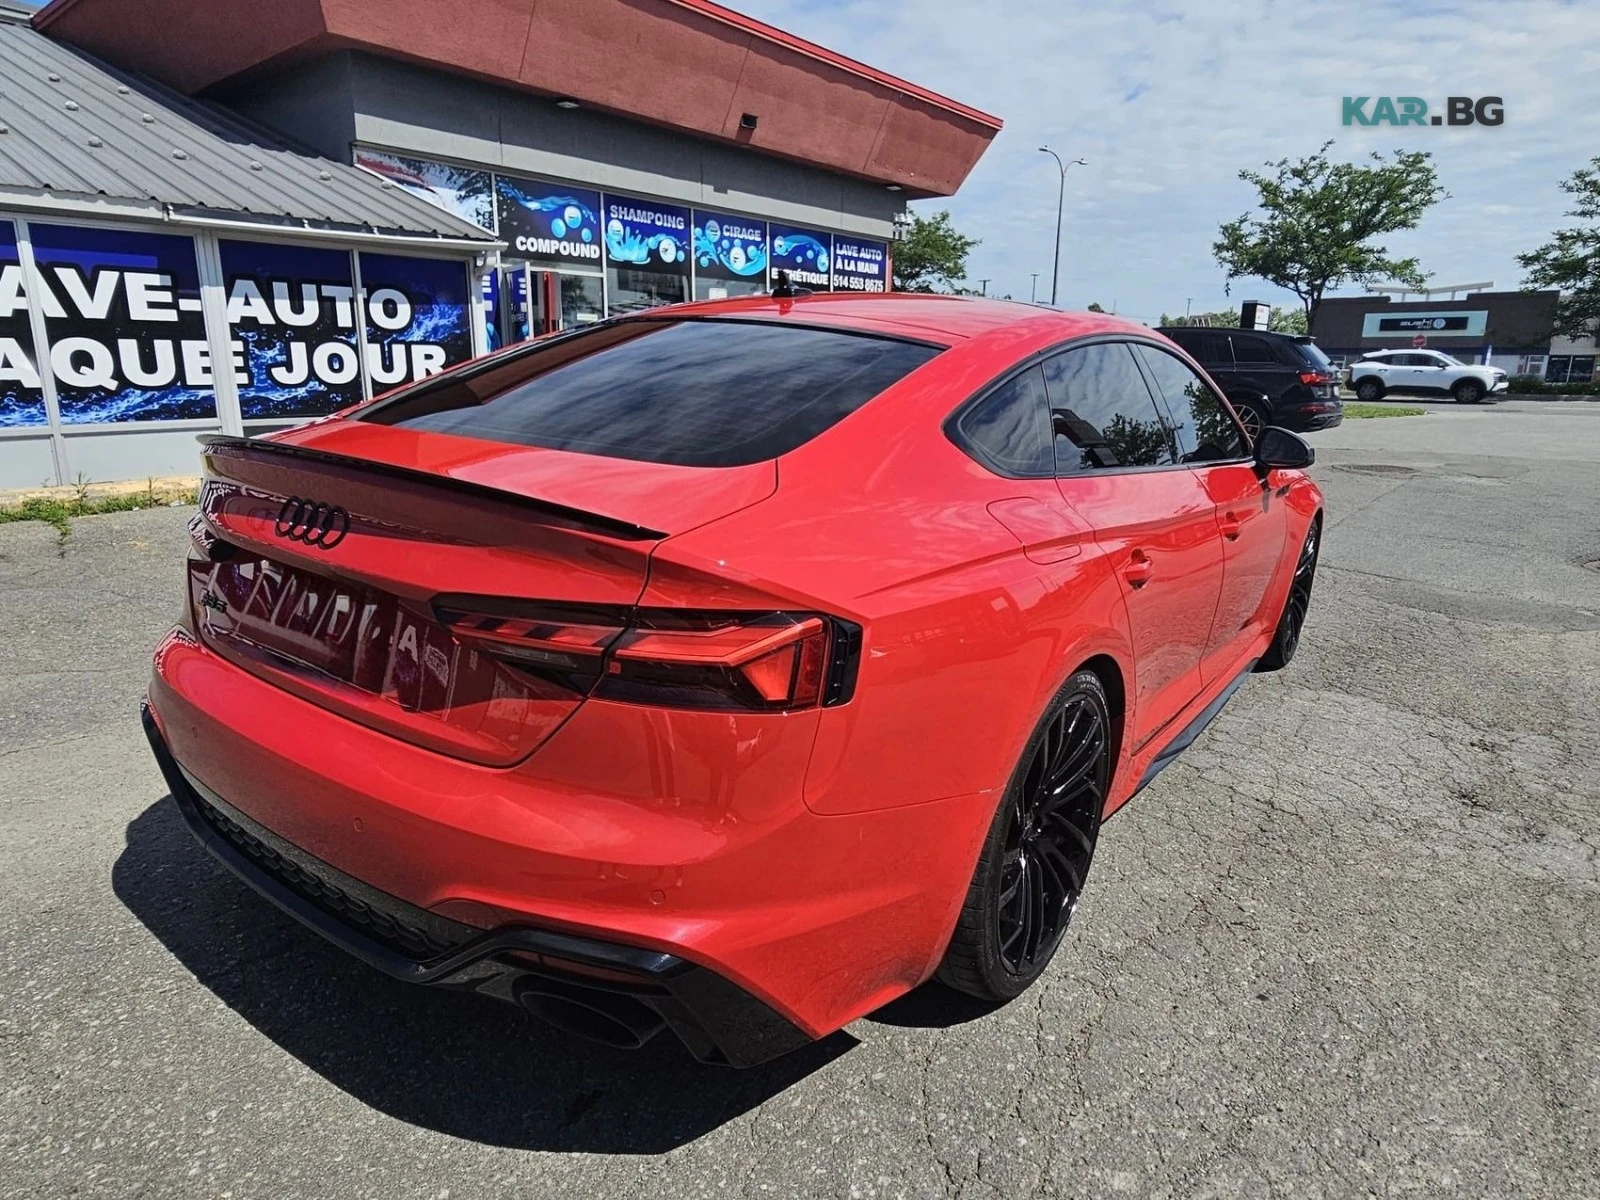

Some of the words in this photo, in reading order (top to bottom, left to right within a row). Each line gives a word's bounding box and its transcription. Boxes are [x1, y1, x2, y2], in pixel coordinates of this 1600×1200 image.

[610, 205, 685, 230] SHAMPOING
[722, 224, 762, 241] CIRAGE
[516, 235, 600, 259] COMPOUND
[836, 243, 858, 257] LAVE
[860, 247, 882, 261] AUTO
[835, 255, 843, 270] À
[844, 259, 856, 272] LA
[857, 261, 879, 275] MAIN
[833, 274, 848, 288] 514
[849, 276, 864, 290] 553
[270, 341, 446, 384] JOUR
